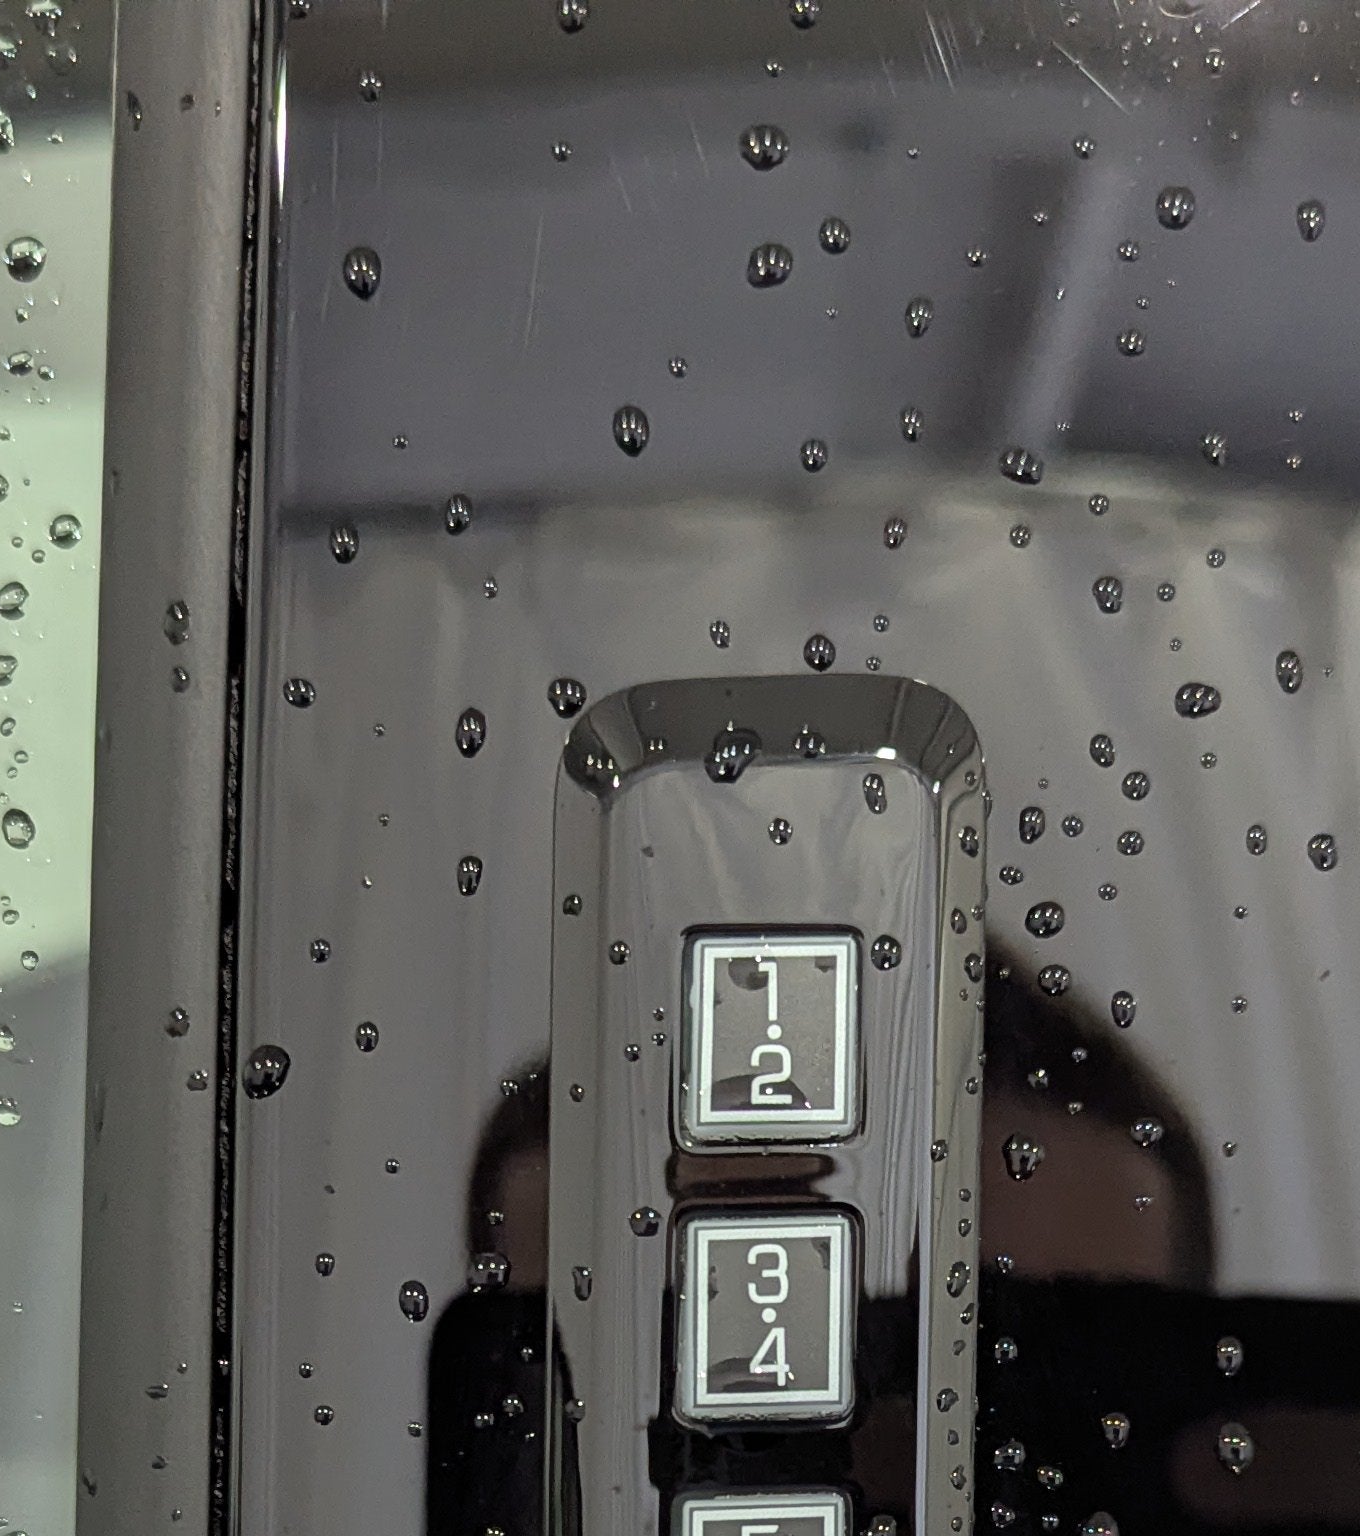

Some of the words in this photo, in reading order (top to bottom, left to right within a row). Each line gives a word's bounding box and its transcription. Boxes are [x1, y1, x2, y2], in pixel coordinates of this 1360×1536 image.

[759, 961, 779, 1022] 1
[750, 1043, 794, 1105] 2
[748, 1243, 790, 1304] 3
[749, 1327, 790, 1387] 4
